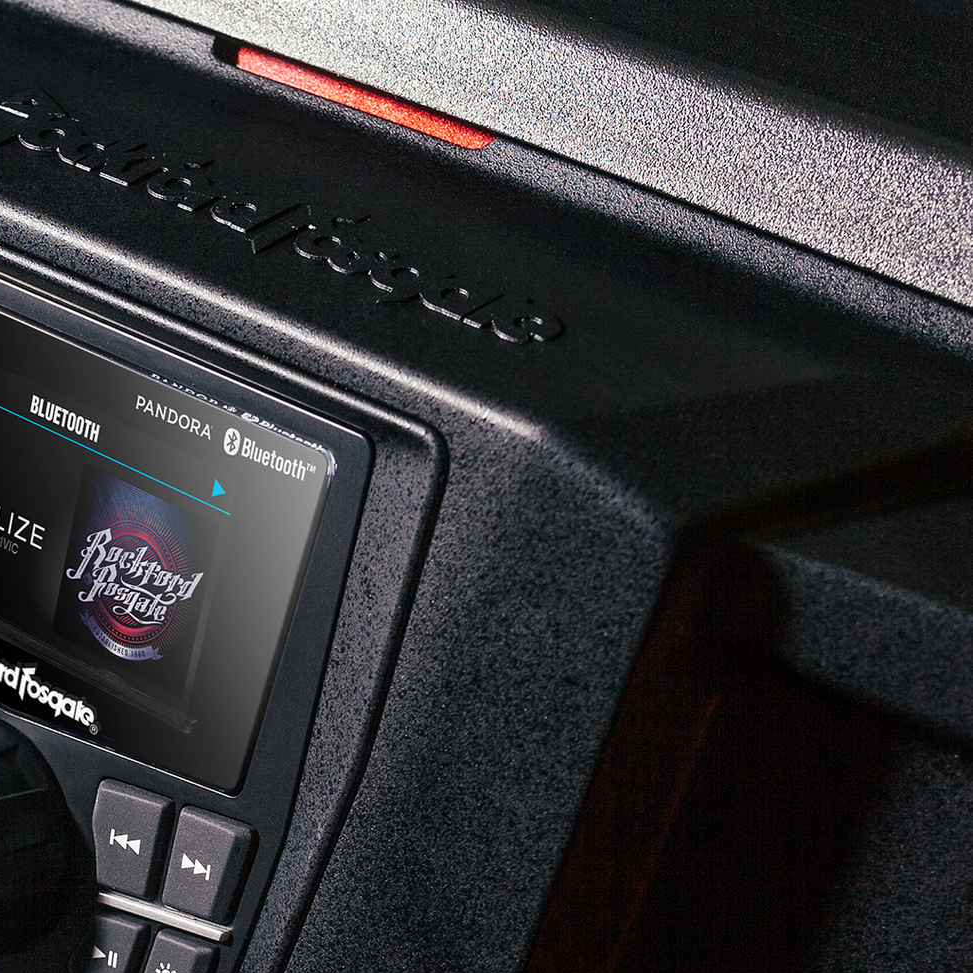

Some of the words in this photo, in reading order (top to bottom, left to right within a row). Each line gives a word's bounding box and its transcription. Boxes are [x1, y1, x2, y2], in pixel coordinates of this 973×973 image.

[29, 394, 101, 444] BLUETOOTH
[135, 394, 212, 441] PANDORA
[66, 528, 204, 601] Rockford
